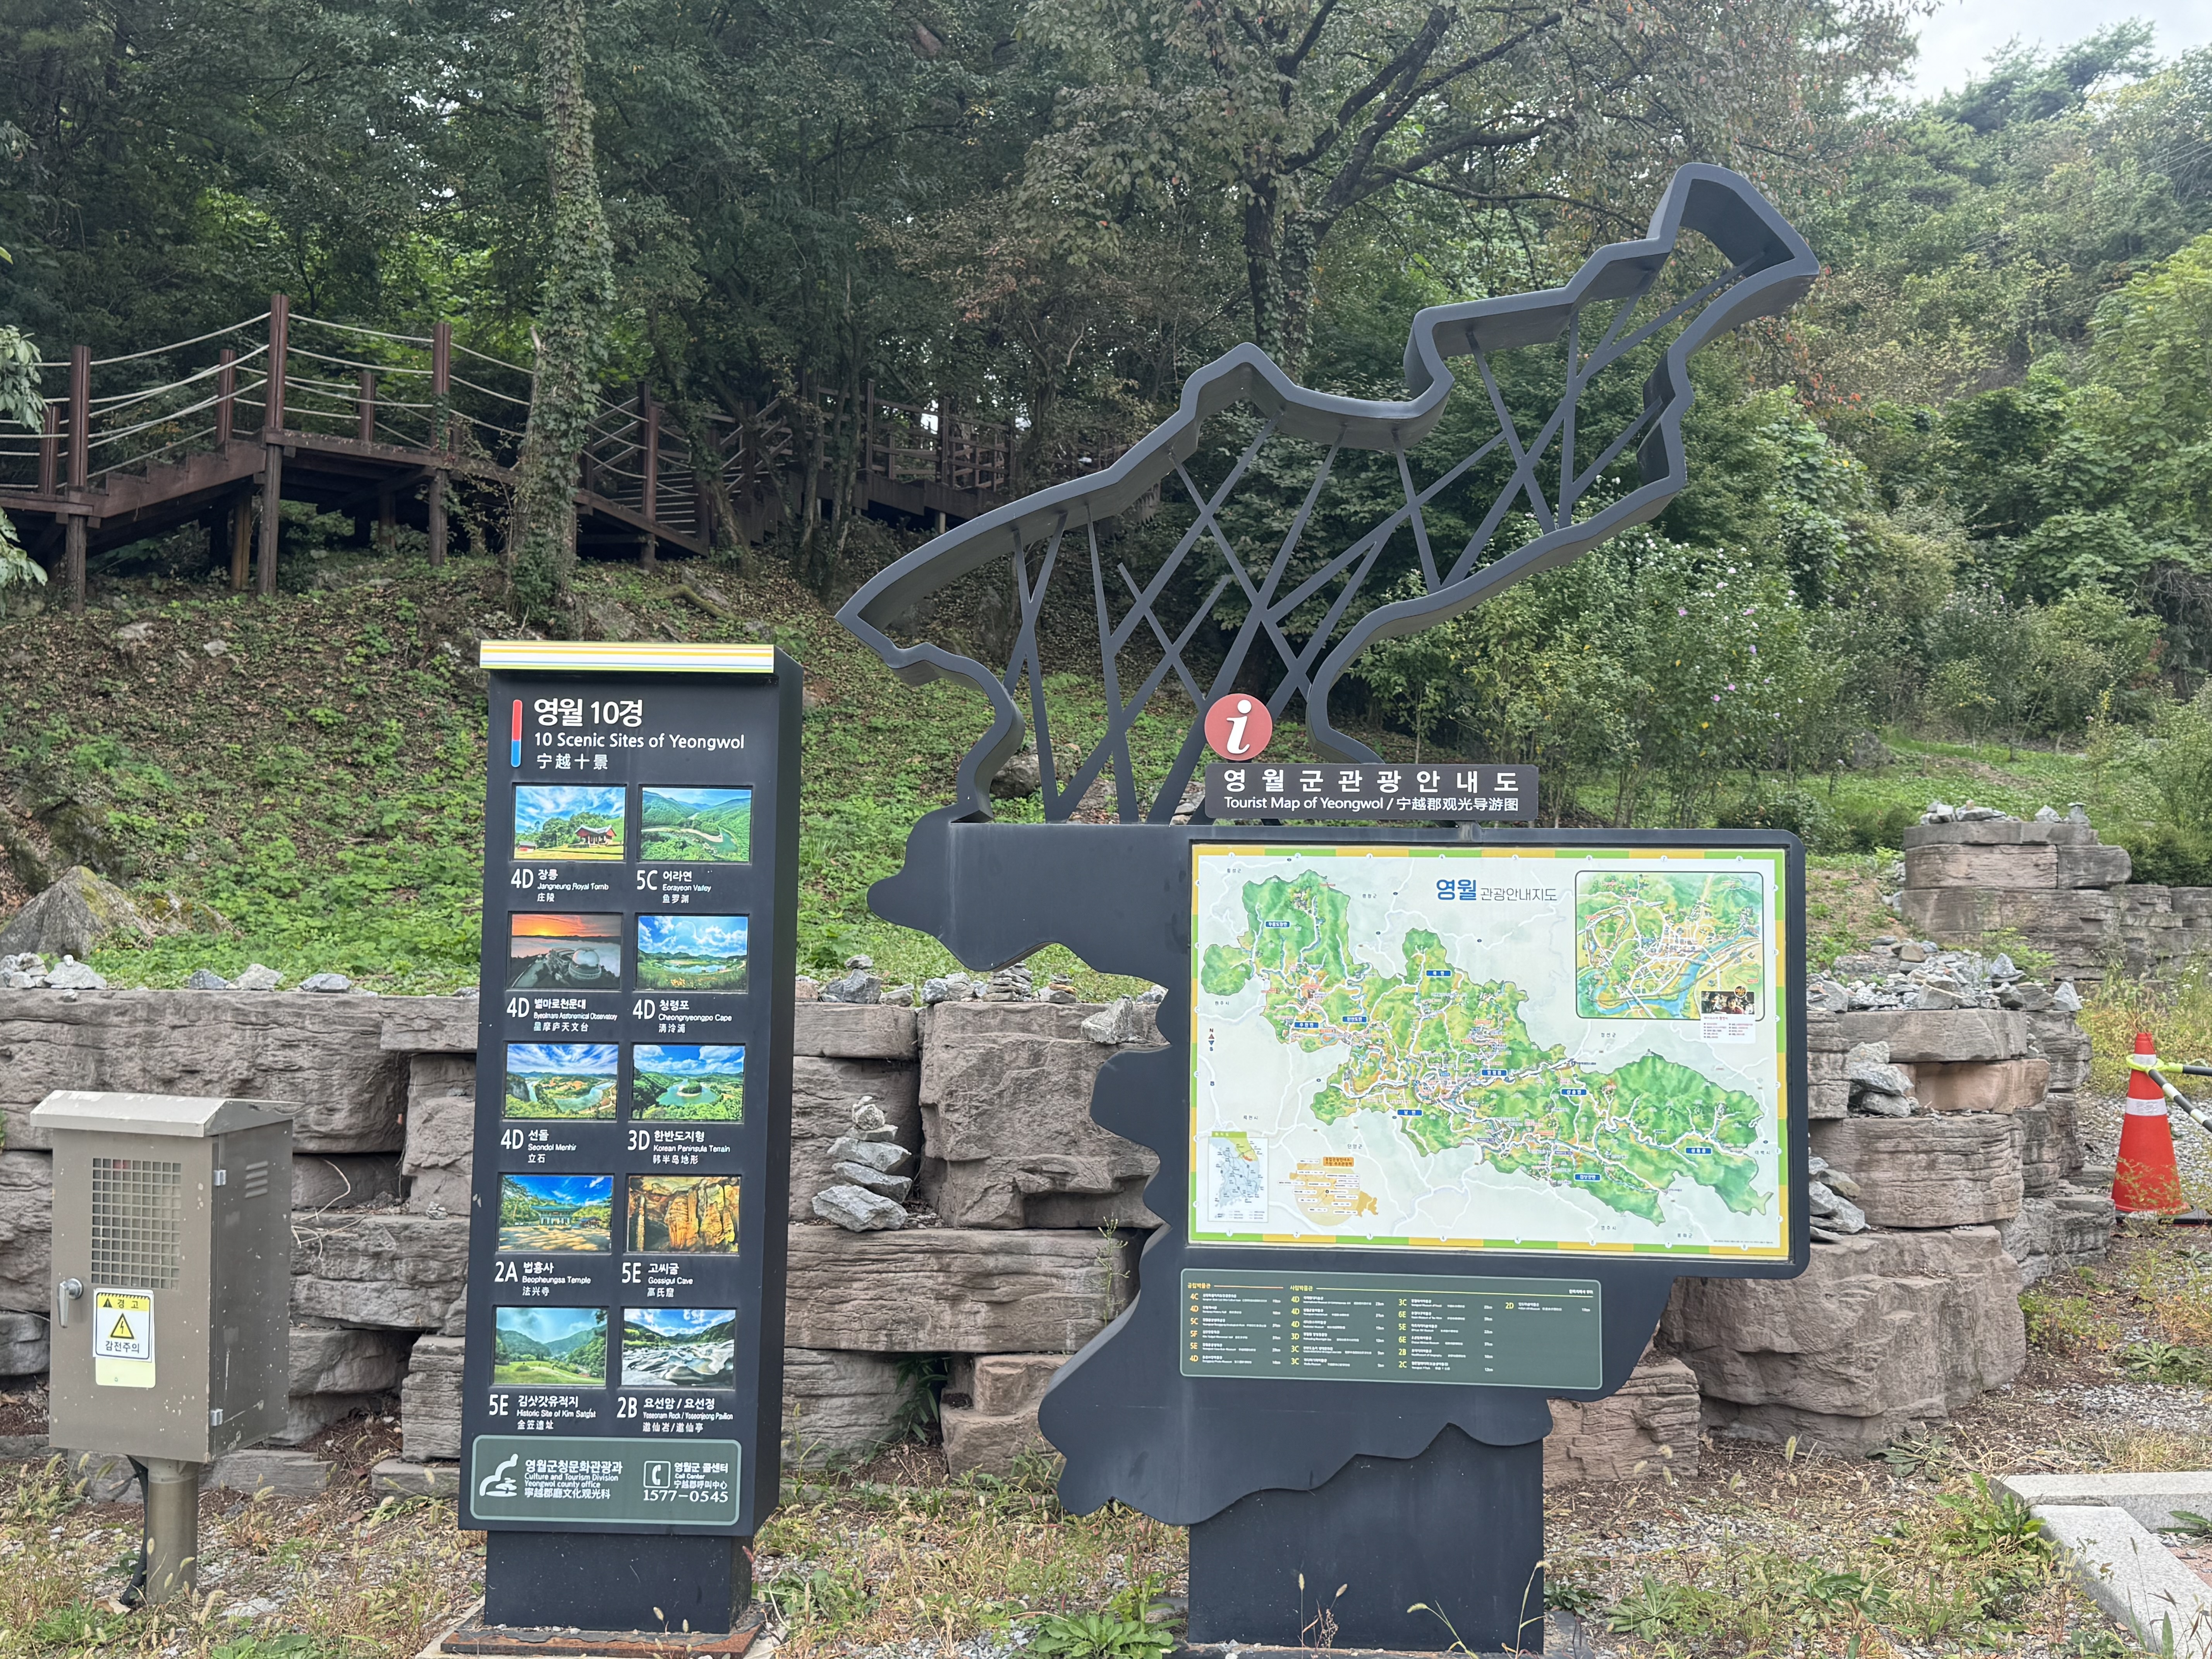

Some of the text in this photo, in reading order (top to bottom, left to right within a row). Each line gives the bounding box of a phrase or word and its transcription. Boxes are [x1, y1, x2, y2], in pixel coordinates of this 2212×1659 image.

[534, 698, 642, 727] 영월 10경
[535, 732, 744, 750] 10 Scenic Sites of Yeongwol
[537, 753, 608, 769] 宁越十景
[1224, 796, 1518, 812] Tourist Map of Yeongwol / 宁越郡观光导游图
[511, 868, 533, 888] 4D
[538, 869, 558, 880] 장릉
[637, 870, 658, 890] 5C
[663, 871, 692, 881] 어라연
[1436, 879, 1557, 901] 영월 관광안내지도
[507, 997, 529, 1017] 4D
[534, 998, 586, 1009] 별마로천문대
[632, 999, 655, 1019] 4D
[659, 1000, 689, 1011] 청령포
[501, 1129, 524, 1149] 4D
[528, 1129, 549, 1141] 선돌
[627, 1130, 649, 1150] 3D
[654, 1130, 704, 1142] 한반도지형
[528, 1153, 545, 1163] 立石
[495, 1261, 518, 1282] 2A
[523, 1261, 554, 1274] 법흥사
[622, 1262, 641, 1283] 5E
[648, 1263, 679, 1275] 고씨굴
[522, 1286, 549, 1296] 法兴寺
[106, 1341, 139, 1353] 감전주의
[489, 1394, 508, 1415] 5E
[518, 1395, 578, 1407] 김삿갓유적지
[617, 1396, 637, 1417] 2B
[644, 1397, 675, 1409] 요선암
[684, 1398, 714, 1410] 요선정
[525, 1459, 623, 1474] 영월군청문화관광과
[674, 1462, 700, 1472] 영월군
[643, 1489, 728, 1502] 1577-0545
